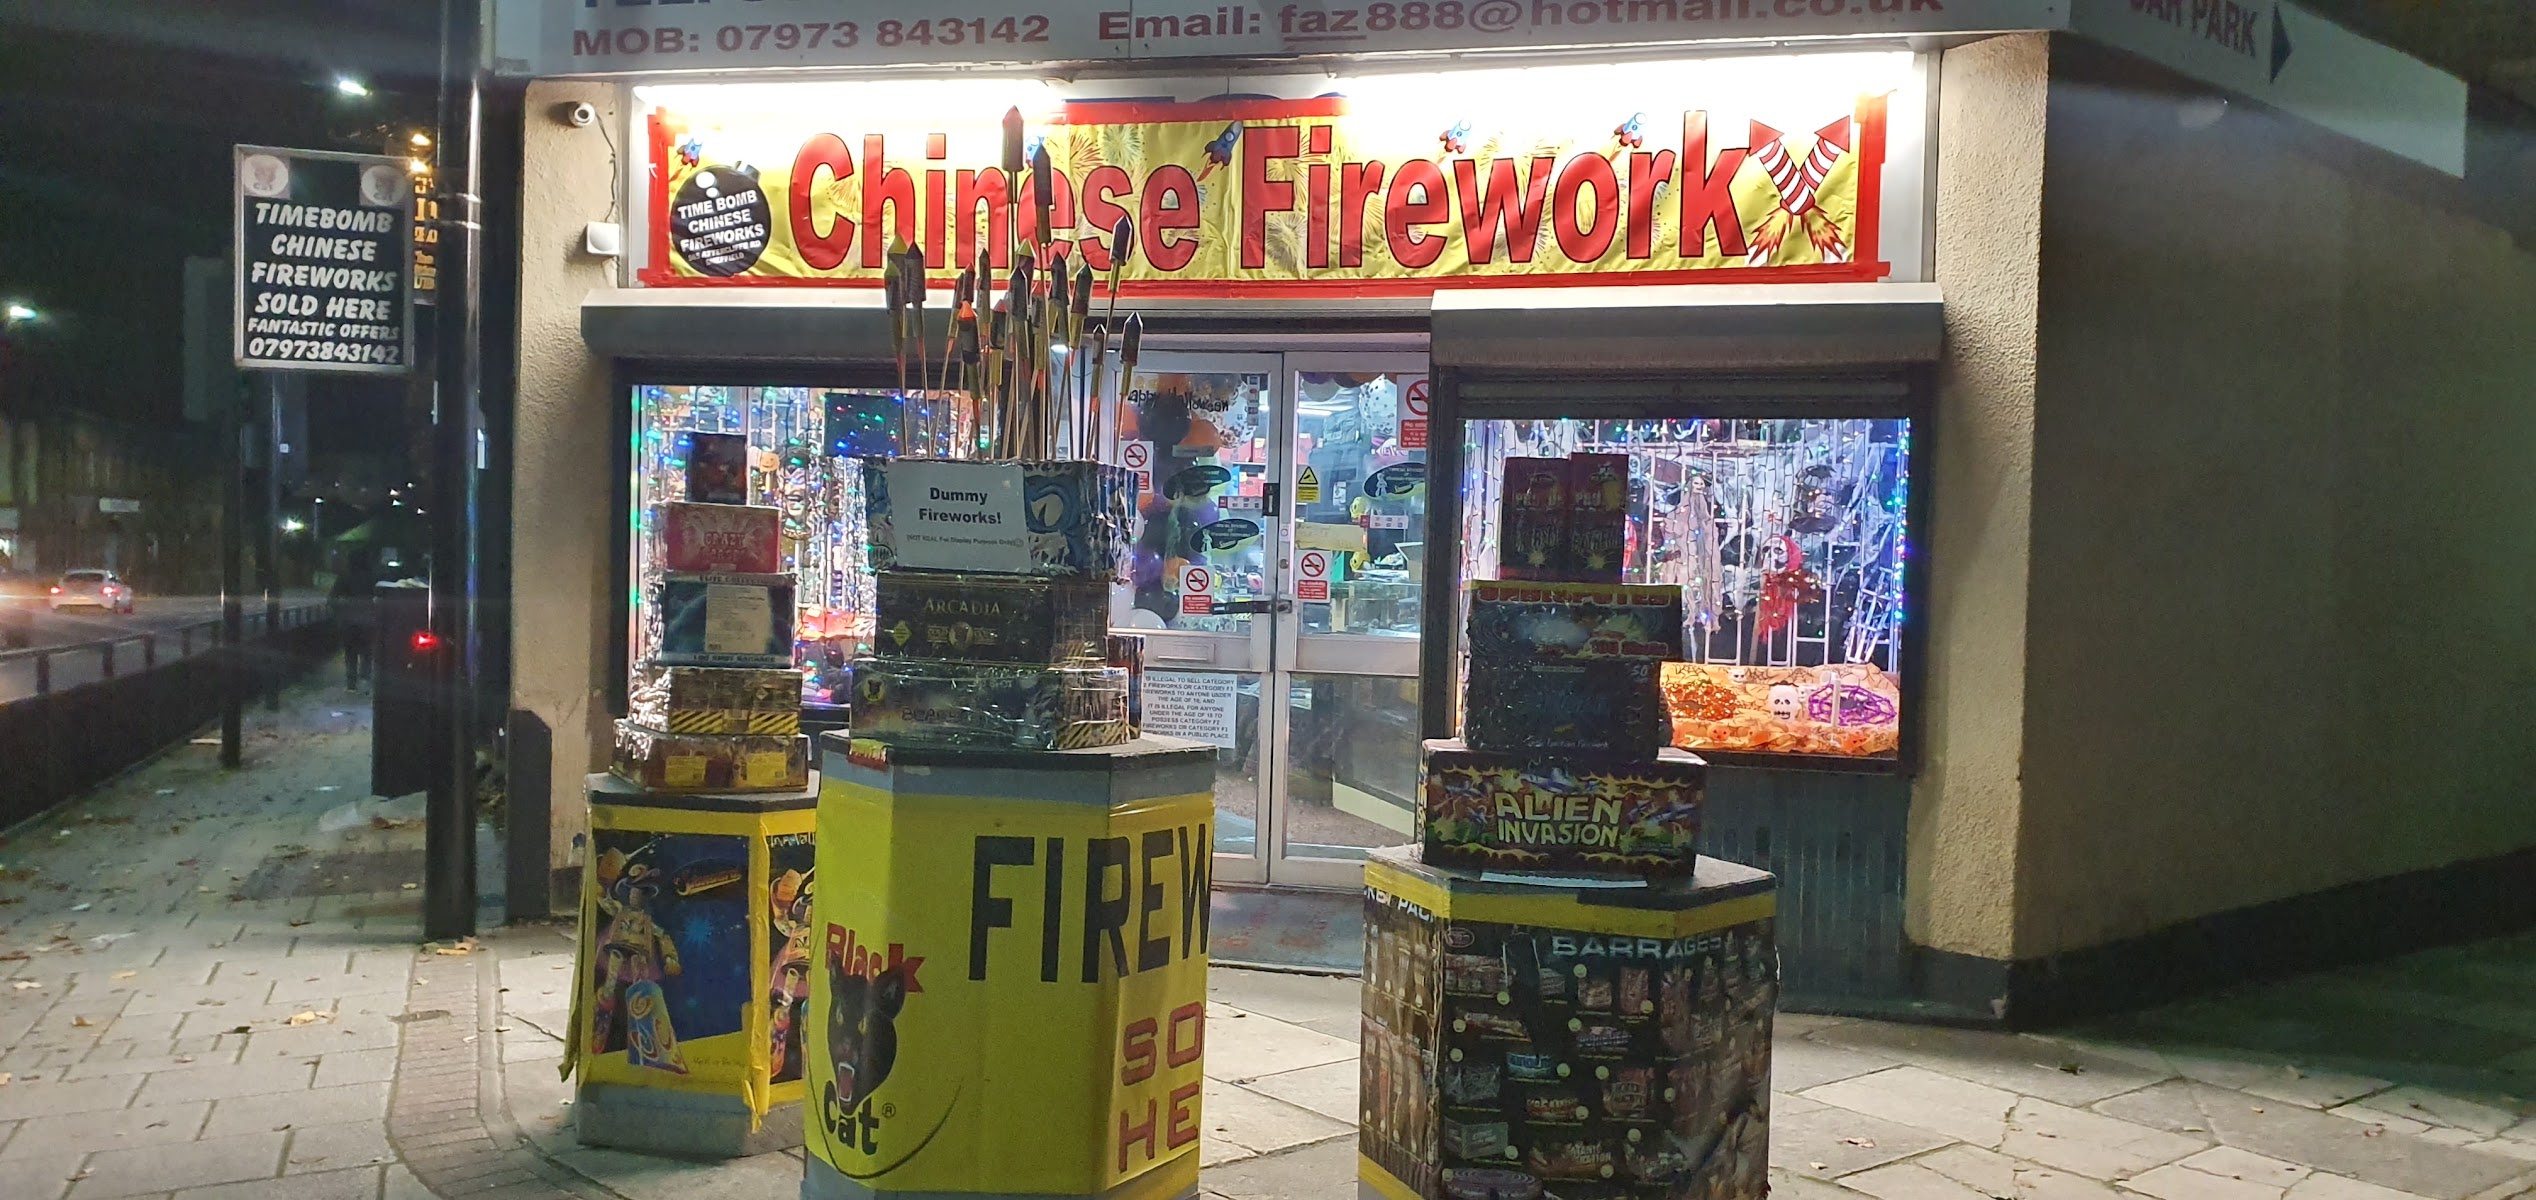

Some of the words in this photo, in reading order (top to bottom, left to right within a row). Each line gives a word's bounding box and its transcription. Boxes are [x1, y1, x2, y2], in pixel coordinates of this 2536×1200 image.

[572, 26, 700, 56] MOB:
[715, 20, 859, 52] 07973
[875, 15, 1050, 47] 843142
[1098, 6, 1261, 42] Email:
[677, 200, 714, 219] TIME
[715, 190, 757, 211] BOMB
[789, 132, 1201, 272] Chinese
[1240, 109, 1752, 269] Firework
[255, 203, 395, 234] TIMEBOMB
[688, 209, 752, 234] CHINESE
[271, 233, 377, 262] CHINESE
[680, 224, 765, 253] FIREWORKS
[251, 262, 397, 292] FIREWORKS
[255, 293, 318, 316] SOLD
[326, 297, 392, 321] HERE
[247, 317, 335, 337] FANTASTIC
[339, 323, 399, 340] OFFERS
[249, 338, 399, 364] 07973843142
[929, 487, 987, 506] Dummy
[919, 508, 1002, 524] Fireworks!
[924, 598, 1000, 615] ARCADIA
[1494, 792, 1623, 825] ALIEN
[1498, 819, 1620, 848] INVASION
[968, 824, 1213, 984] FIREW
[826, 922, 927, 994] Black
[1120, 1001, 1204, 1087] SO
[1118, 1082, 1201, 1173] HE
